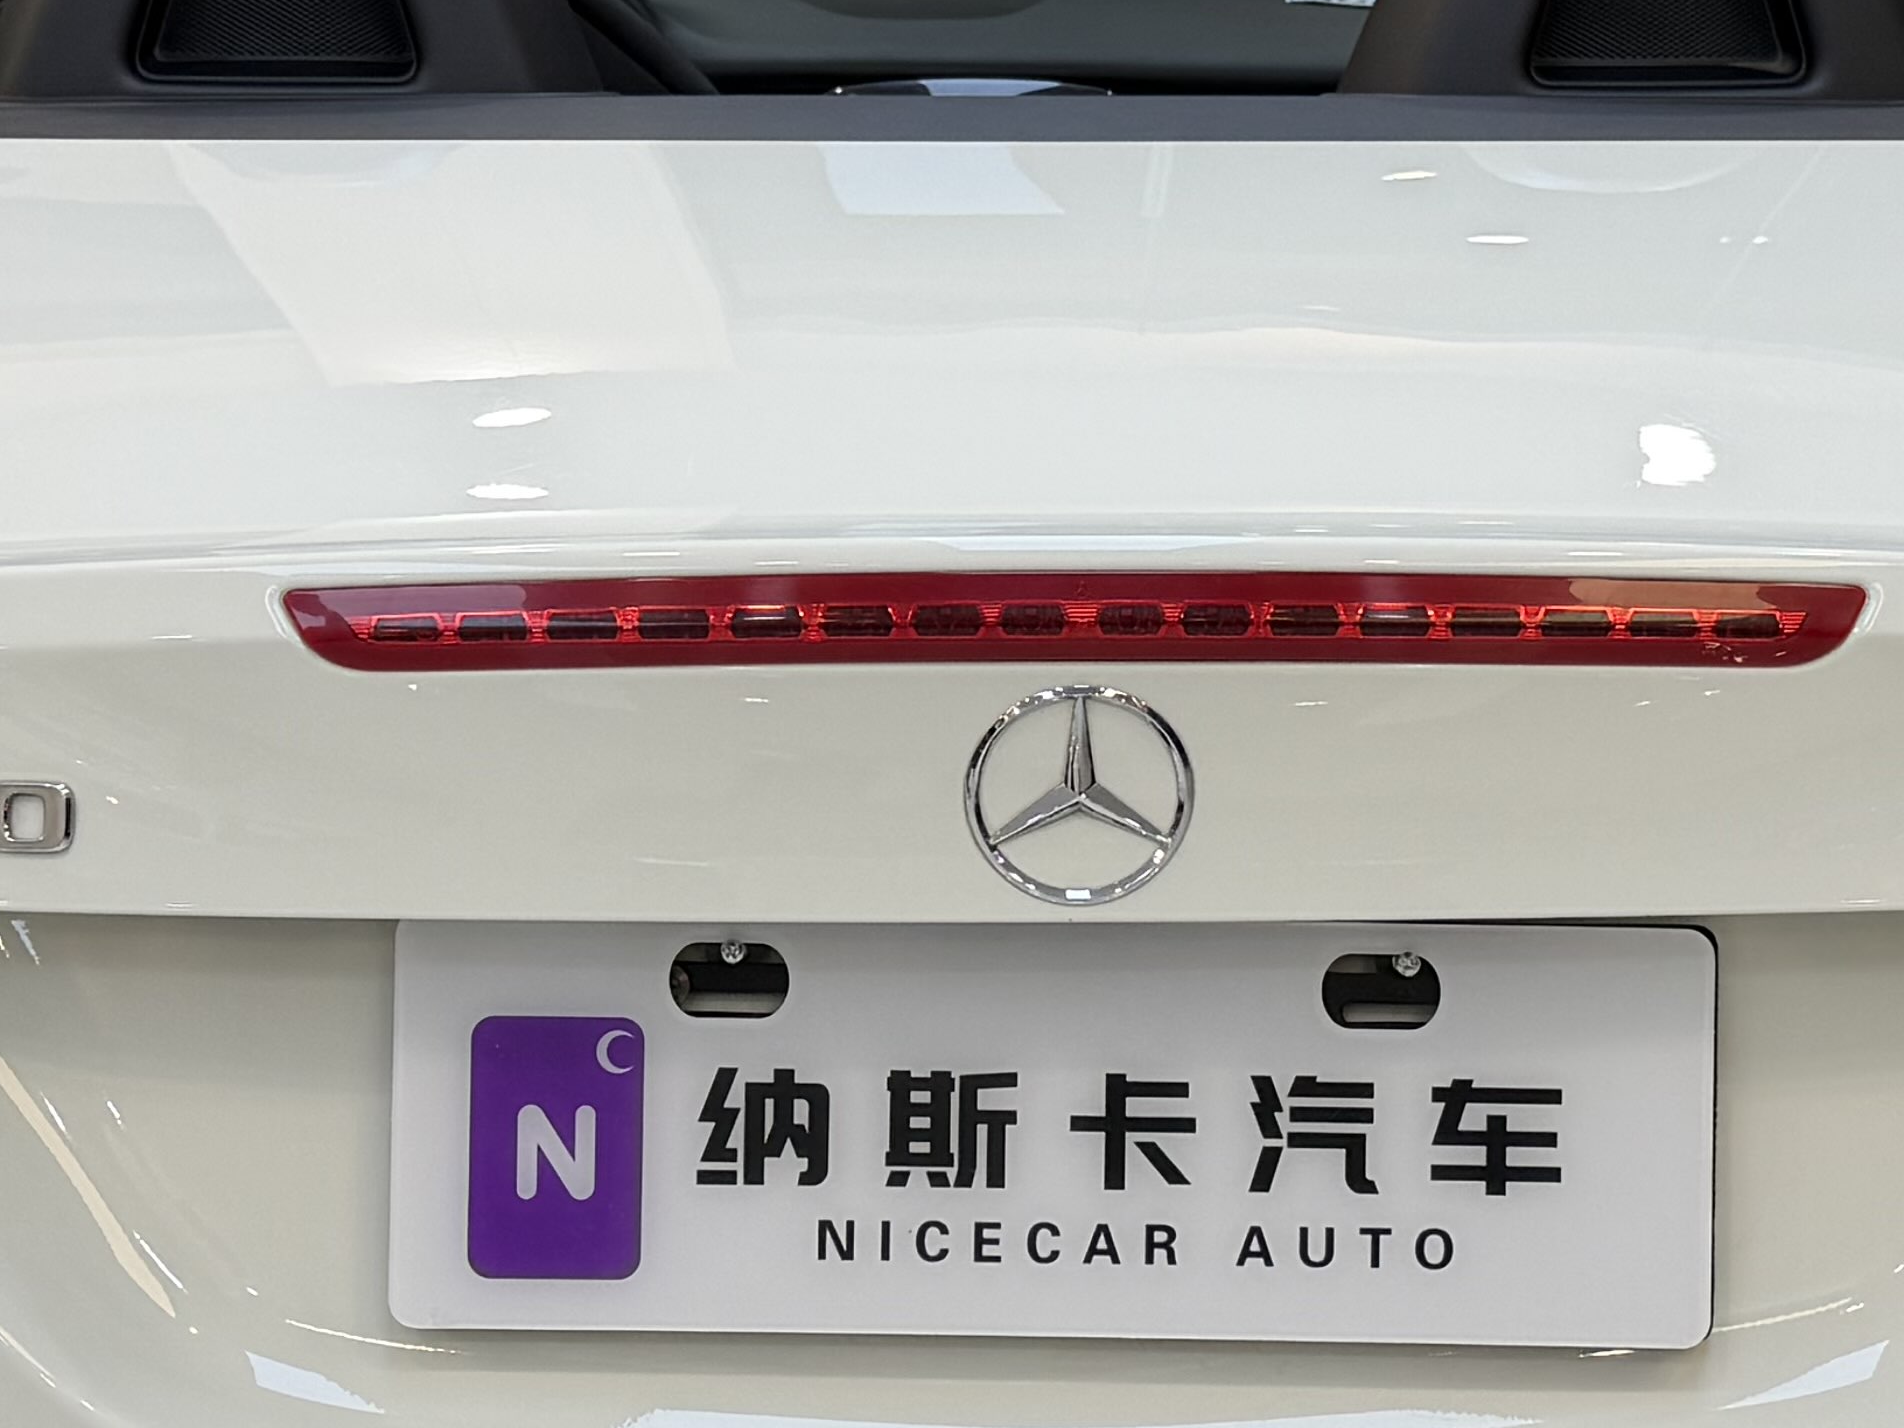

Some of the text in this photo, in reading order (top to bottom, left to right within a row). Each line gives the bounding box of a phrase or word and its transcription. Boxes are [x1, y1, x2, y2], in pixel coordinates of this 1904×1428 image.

[516, 1104, 596, 1201] N
[696, 1068, 1563, 1196] 纳斯卡汽车
[816, 1219, 1455, 1270] NICECAR AUTO
